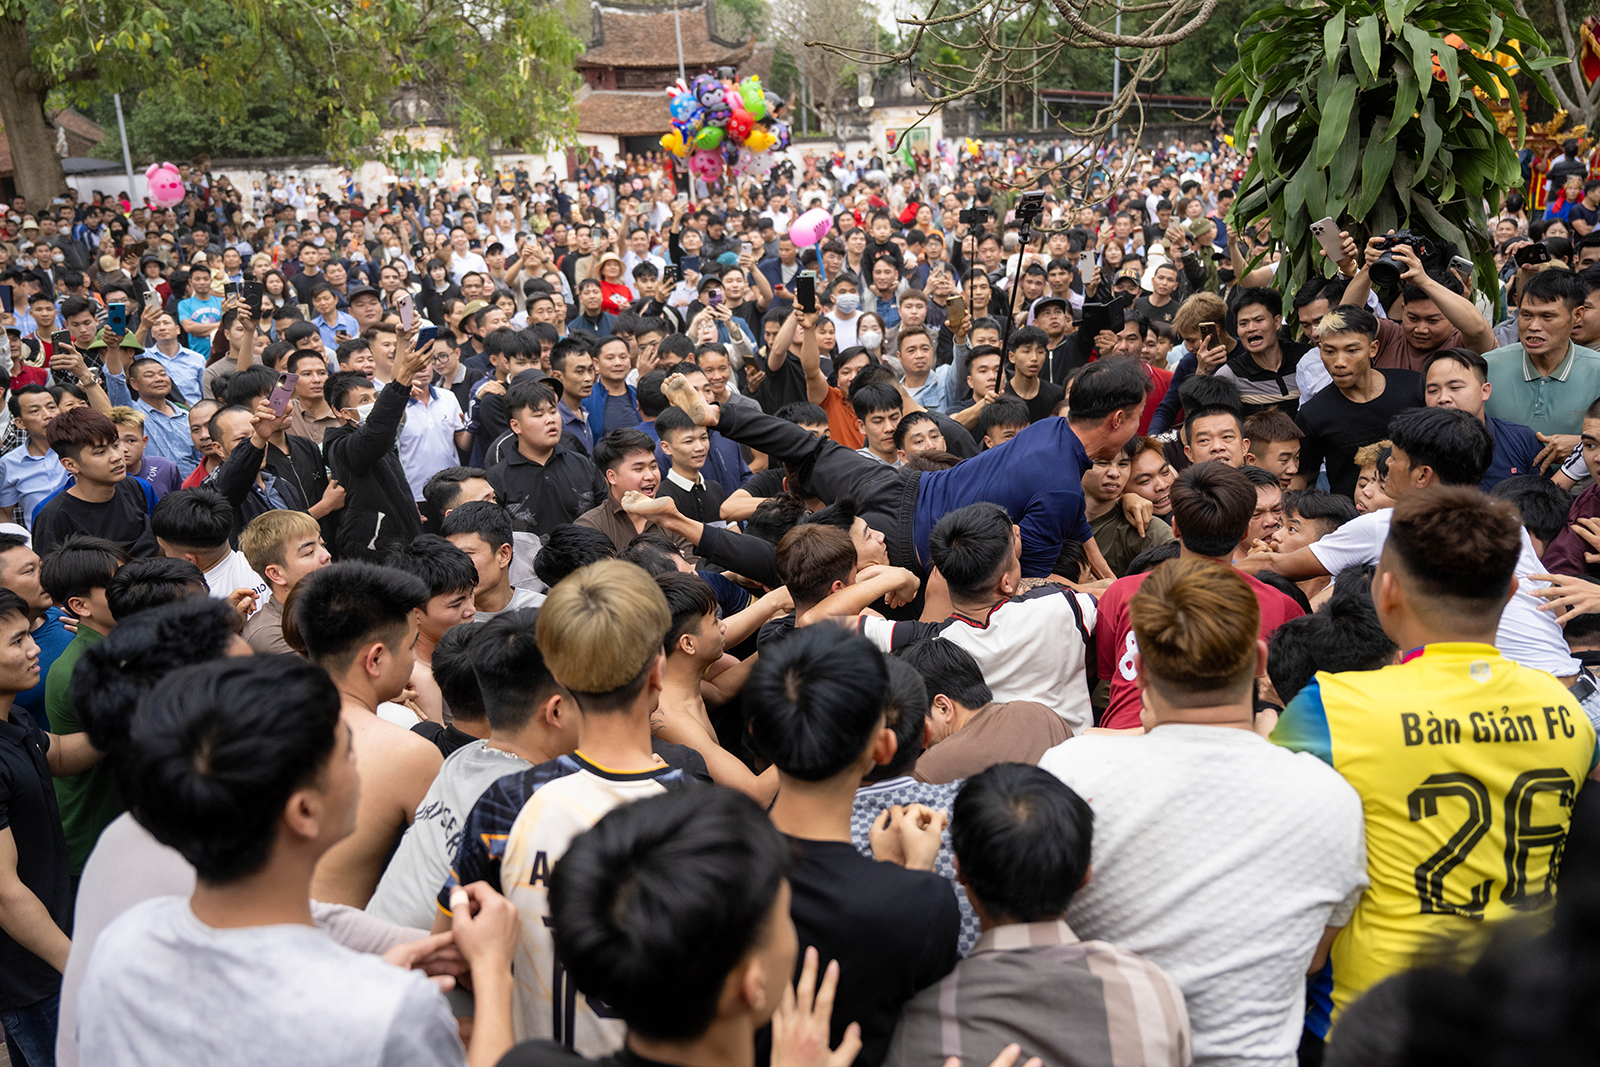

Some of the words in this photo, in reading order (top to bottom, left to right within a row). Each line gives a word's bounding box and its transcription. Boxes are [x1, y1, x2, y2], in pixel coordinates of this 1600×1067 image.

[1401, 710, 1460, 746] Bàn
[1469, 705, 1538, 743] Giản
[1542, 704, 1575, 740] FC
[1407, 767, 1575, 921] 26
